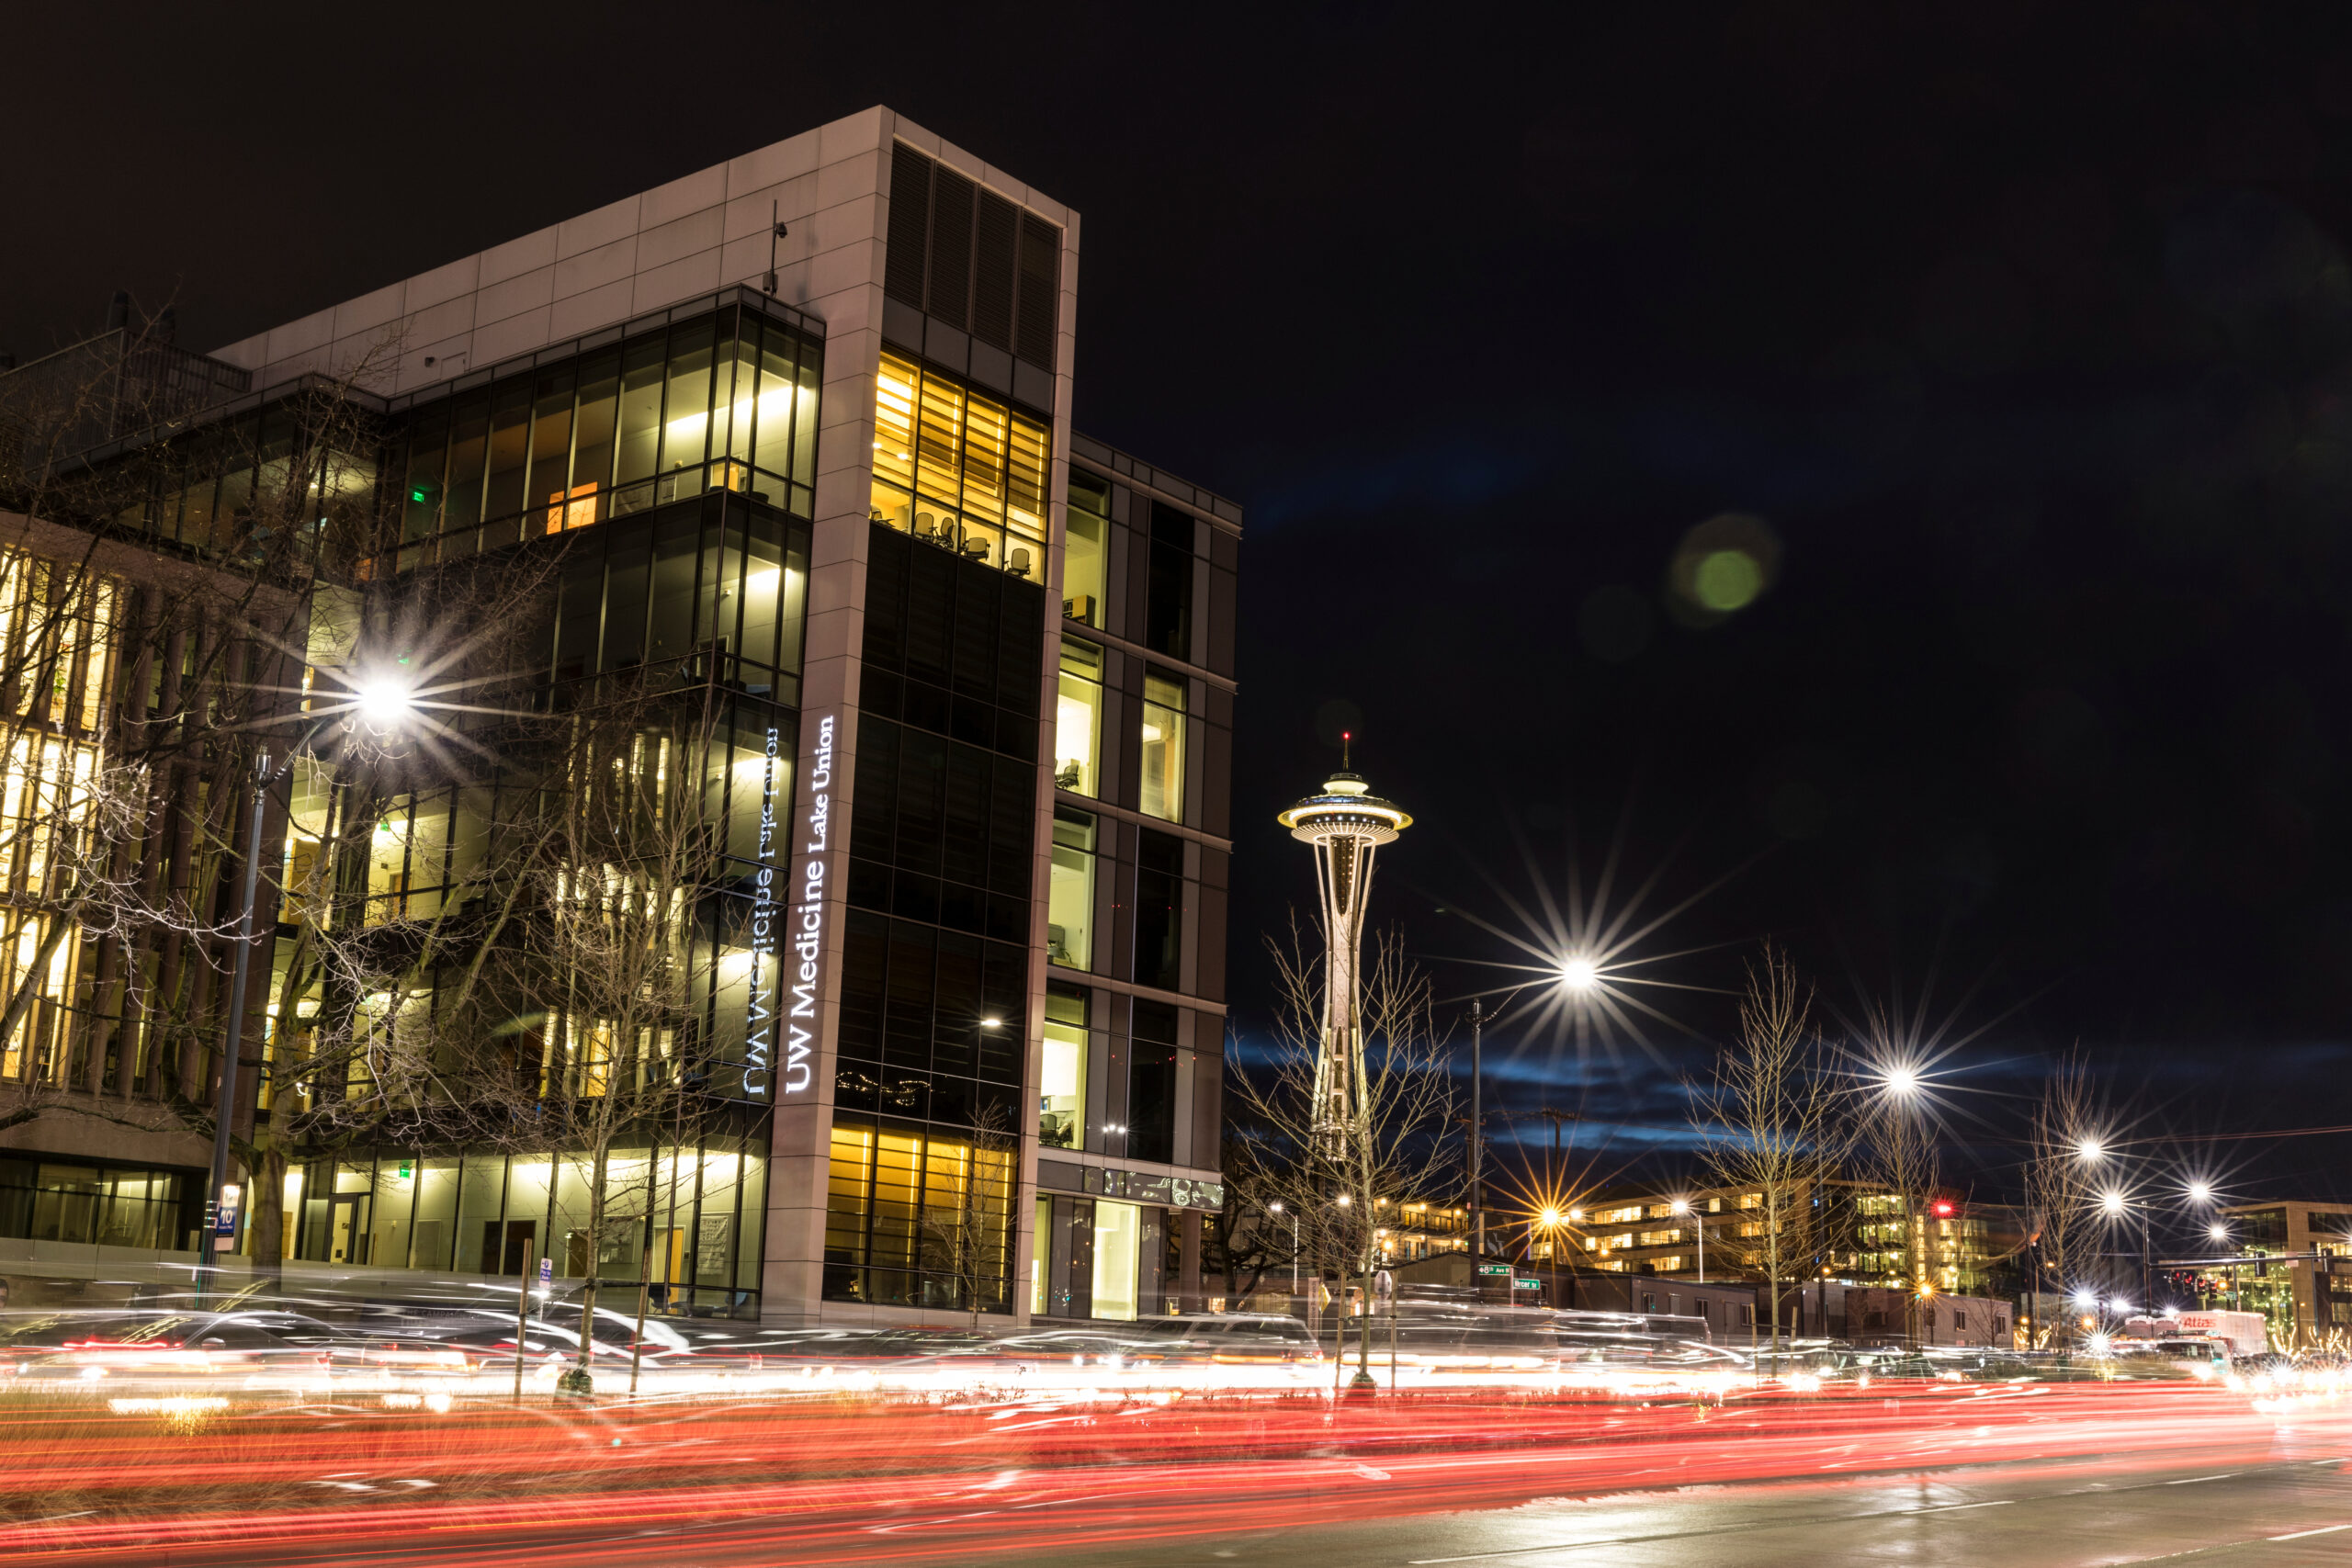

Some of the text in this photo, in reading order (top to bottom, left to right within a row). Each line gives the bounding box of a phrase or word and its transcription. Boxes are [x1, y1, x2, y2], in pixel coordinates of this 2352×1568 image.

[786, 715, 834, 1095] UW Medicine Lake Union
[220, 1210, 232, 1224] 10
